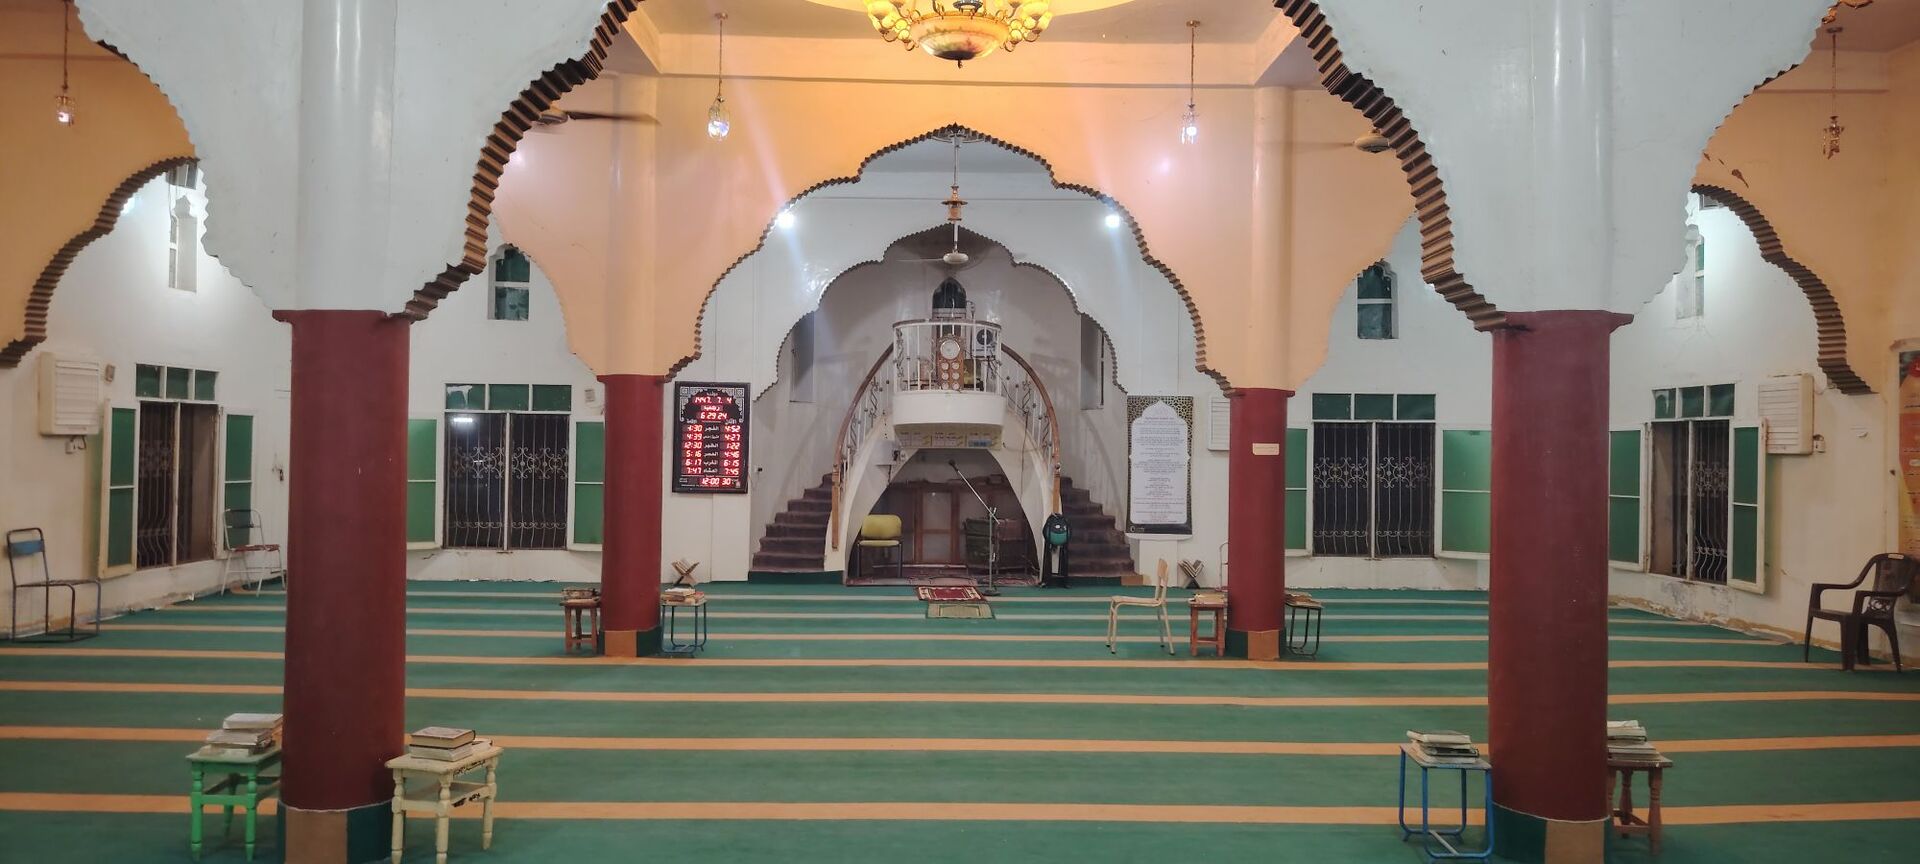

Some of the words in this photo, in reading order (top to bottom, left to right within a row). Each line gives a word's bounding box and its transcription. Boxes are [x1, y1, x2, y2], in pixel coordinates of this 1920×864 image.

[684, 441, 702, 449] 12:30
[685, 458, 702, 466] 6:17
[701, 477, 720, 485] 12:00
